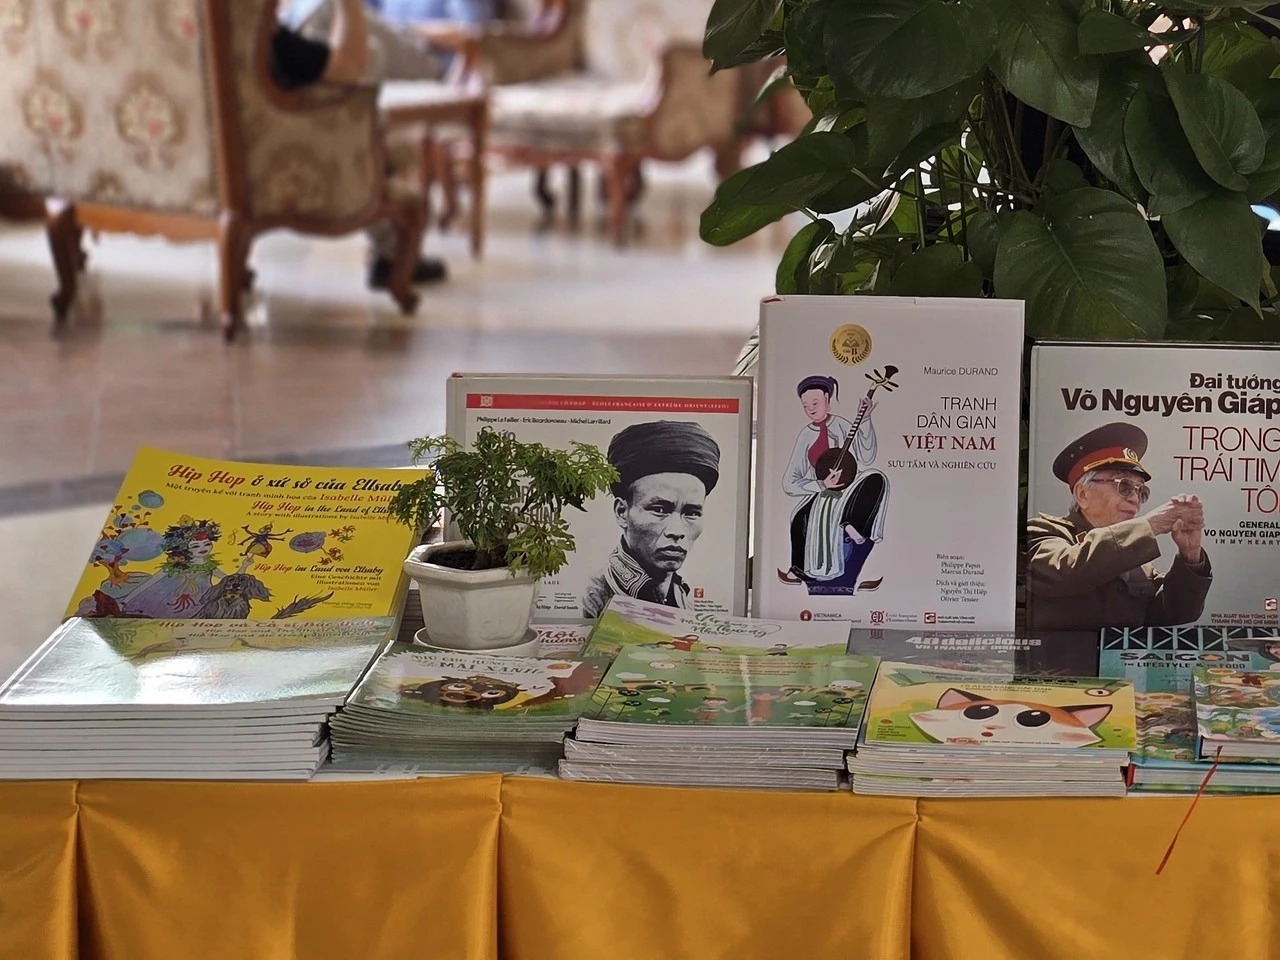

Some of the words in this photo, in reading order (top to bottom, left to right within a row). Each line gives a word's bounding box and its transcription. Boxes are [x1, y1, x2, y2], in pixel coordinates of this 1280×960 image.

[924, 366, 956, 375] Maurice
[958, 367, 998, 376] DURAND
[1190, 372, 1222, 392] Đại
[940, 396, 996, 410] TRANH
[1061, 388, 1098, 411] Võ
[917, 412, 951, 428] DÂN
[956, 415, 996, 429] GIAN
[902, 432, 947, 453] VIỆT
[951, 436, 996, 450] NAM
[888, 460, 905, 468] SƯU
[928, 460, 940, 468] VÀ
[1173, 453, 1234, 482] TRÁI
[168, 464, 203, 484] Hip
[208, 470, 246, 489] Hop
[315, 478, 347, 490] của
[320, 494, 364, 502] Isabelle
[368, 494, 396, 502] Müll
[251, 500, 274, 512] Hip
[276, 502, 302, 514] Hop
[334, 505, 360, 514] Land
[361, 506, 372, 515] of
[1239, 521, 1280, 529] GENERAL
[1219, 530, 1256, 538] NGUYEN
[254, 563, 271, 573] Hip
[274, 564, 292, 574] Hop
[310, 565, 334, 573] Land
[942, 637, 1042, 646] delicious
[1120, 652, 1250, 662] SAIGON
